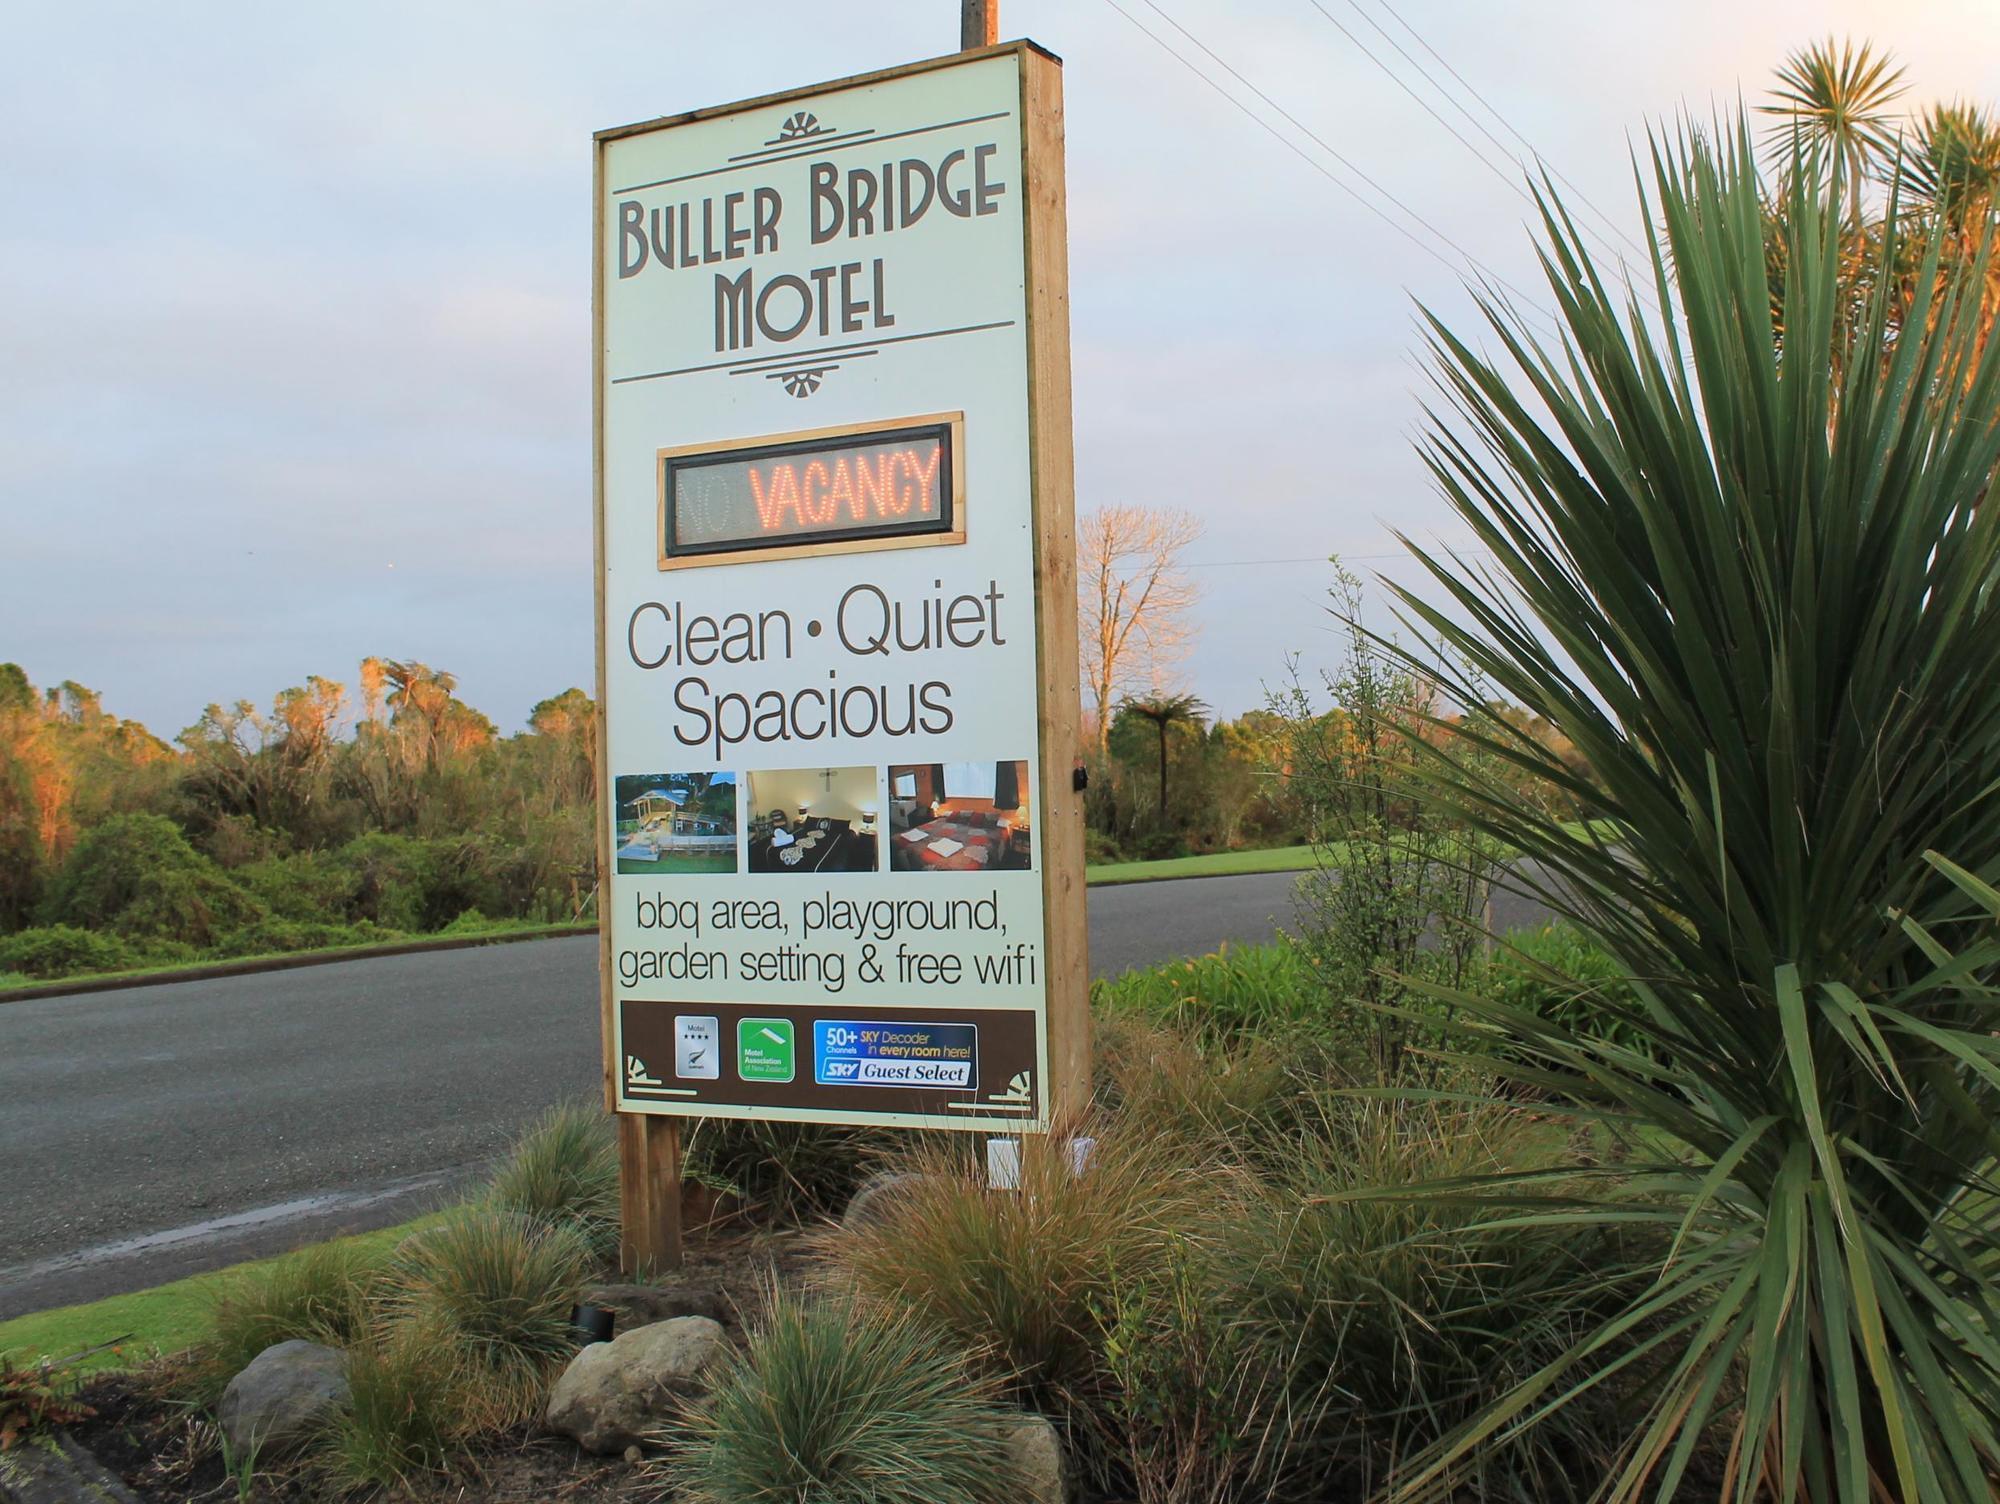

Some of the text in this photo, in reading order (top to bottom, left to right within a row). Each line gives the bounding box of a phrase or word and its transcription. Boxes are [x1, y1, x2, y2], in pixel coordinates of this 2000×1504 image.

[619, 143, 1005, 279] BULLER BRIDGE
[715, 258, 895, 352] MOTEL
[749, 447, 943, 529] VACANCY
[628, 579, 1006, 669] Clean Quiet
[673, 669, 953, 761] Spacious
[637, 890, 1007, 940] bbq area, playground,
[619, 942, 1036, 992] garden setting & free wifi
[687, 1024, 705, 1032] Motel
[826, 1028, 857, 1046] 50+
[860, 1030, 930, 1045] SKY Decoder
[744, 1048, 763, 1056] Motel
[826, 1046, 857, 1054] Channels
[868, 1043, 971, 1059] in every room here!
[744, 1057, 782, 1065] Association
[826, 1062, 965, 1081] SKY Guest Select
